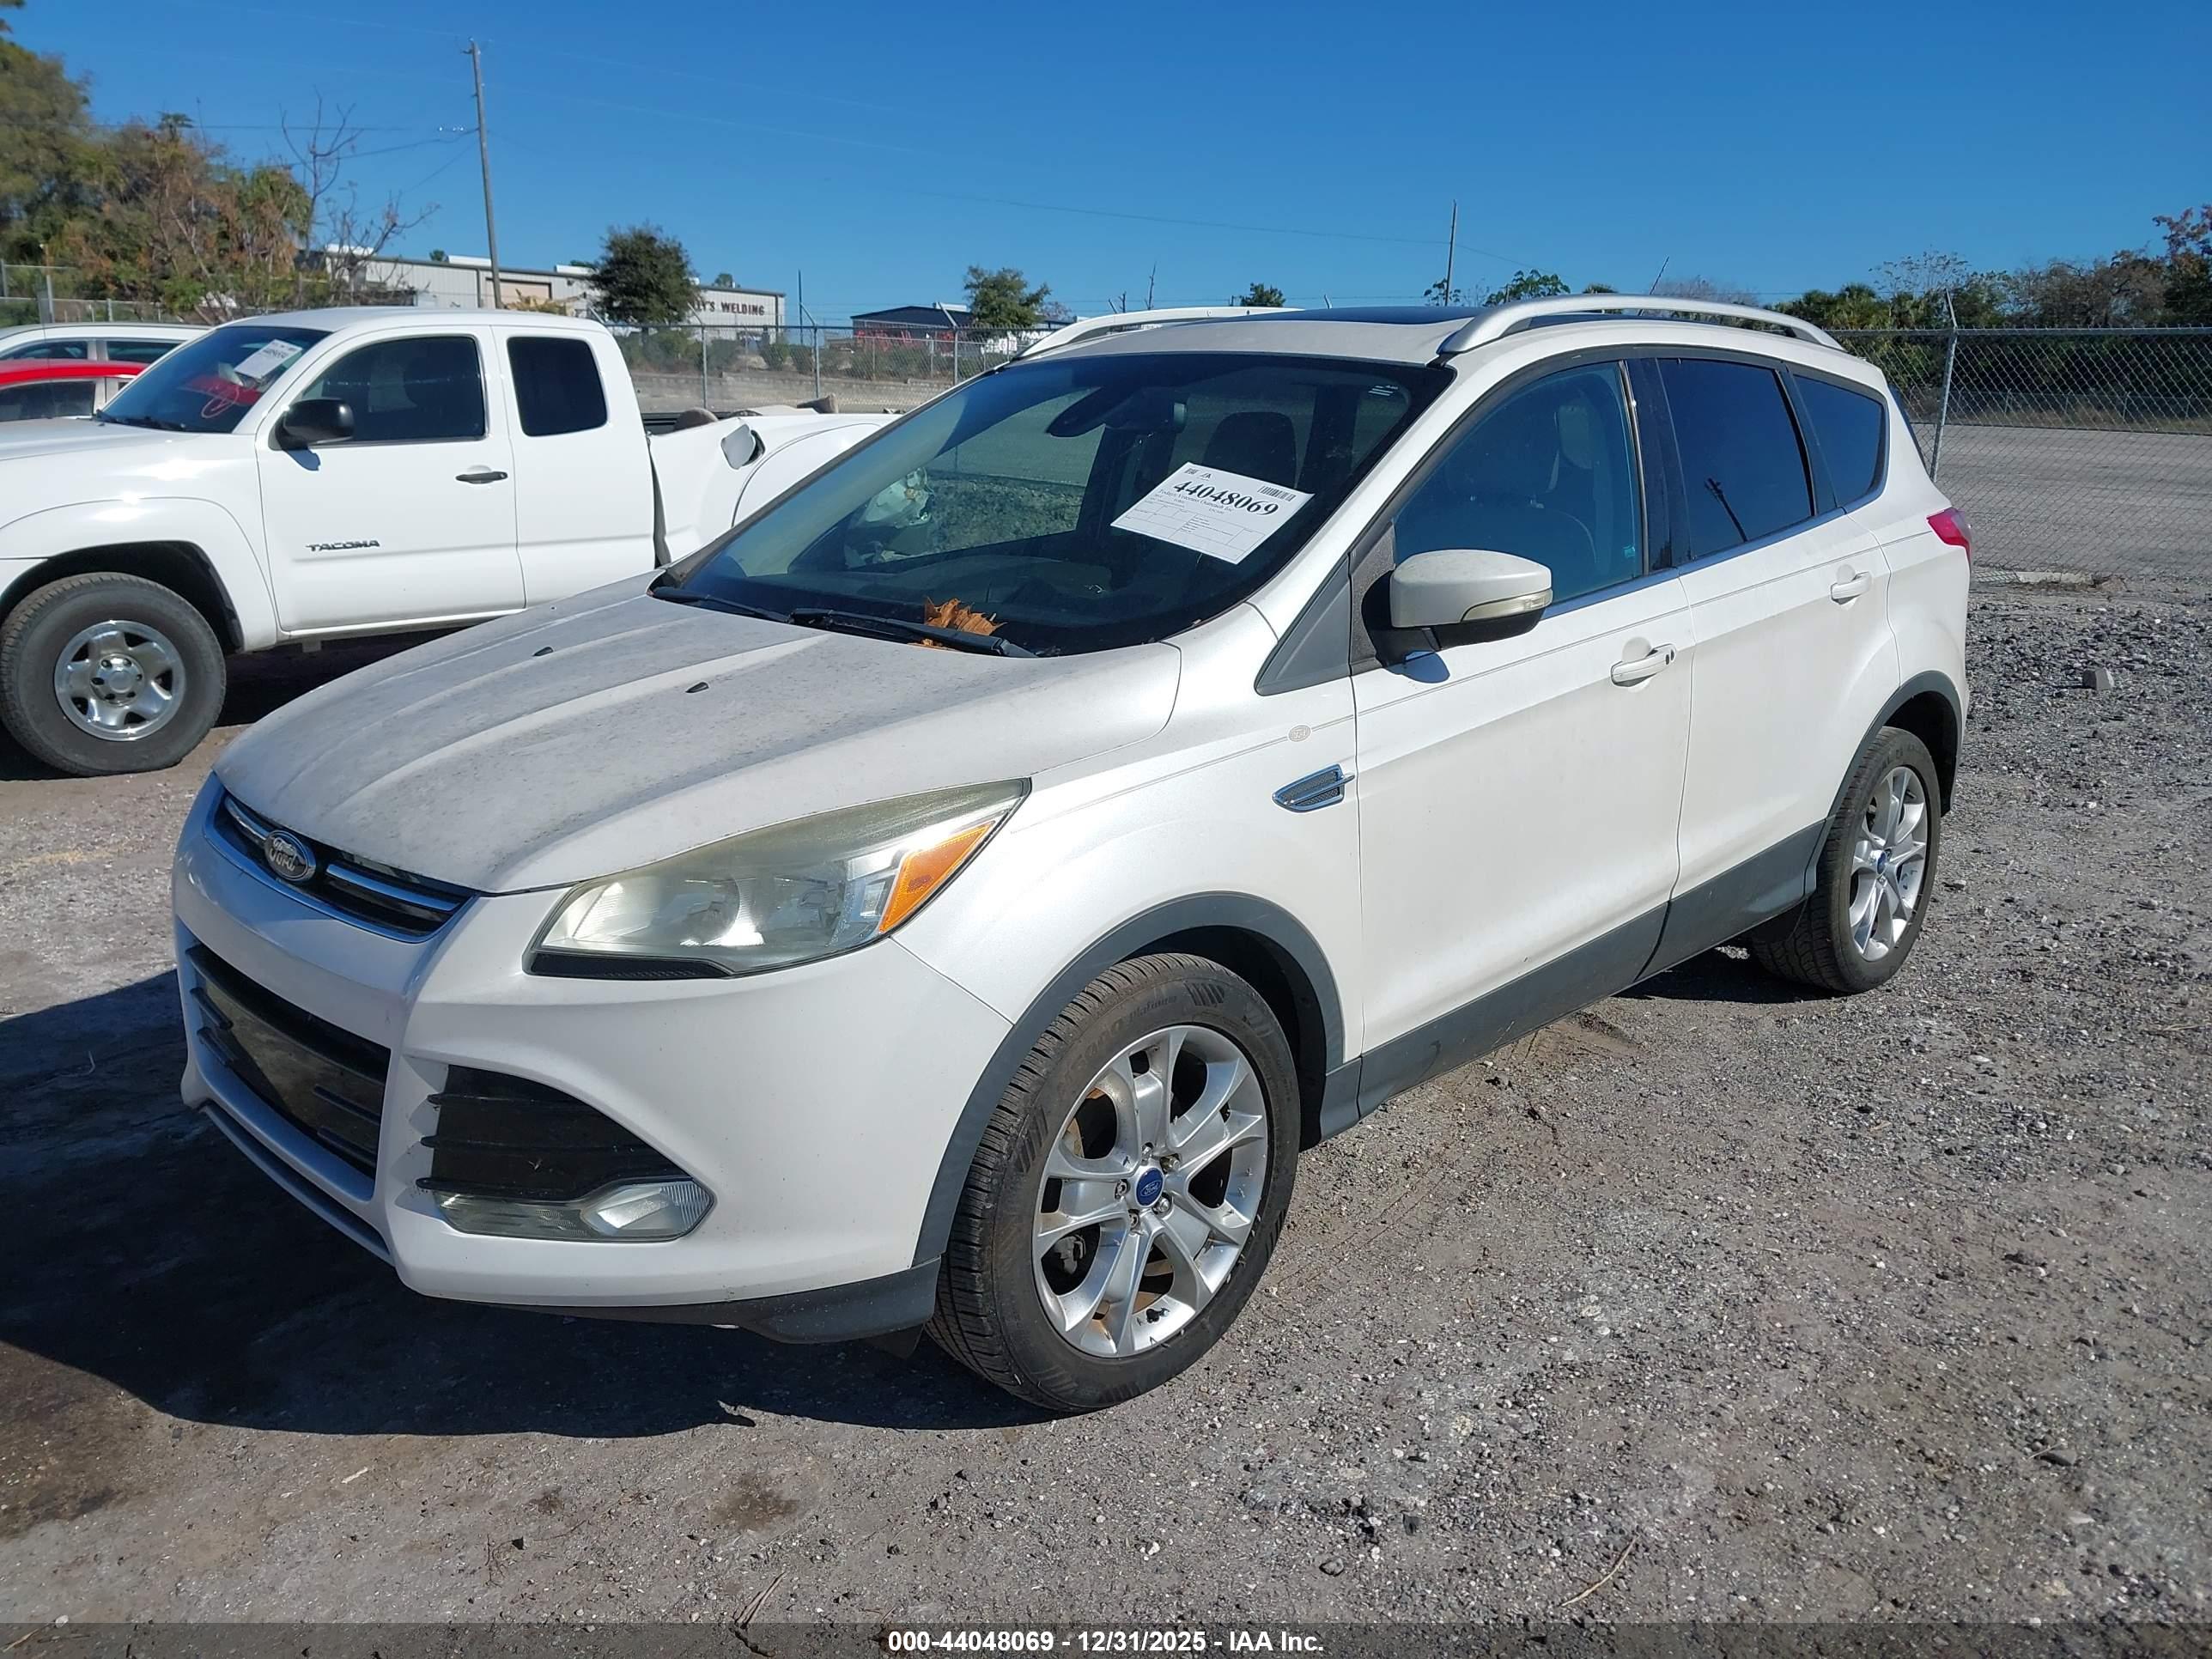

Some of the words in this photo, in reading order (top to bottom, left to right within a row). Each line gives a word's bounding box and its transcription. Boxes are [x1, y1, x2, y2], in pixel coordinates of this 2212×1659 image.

[721, 301, 765, 315] WELDING
[1173, 481, 1279, 515] 44048069
[306, 540, 380, 551] TACOMA
[1141, 1181, 1160, 1195] Ford
